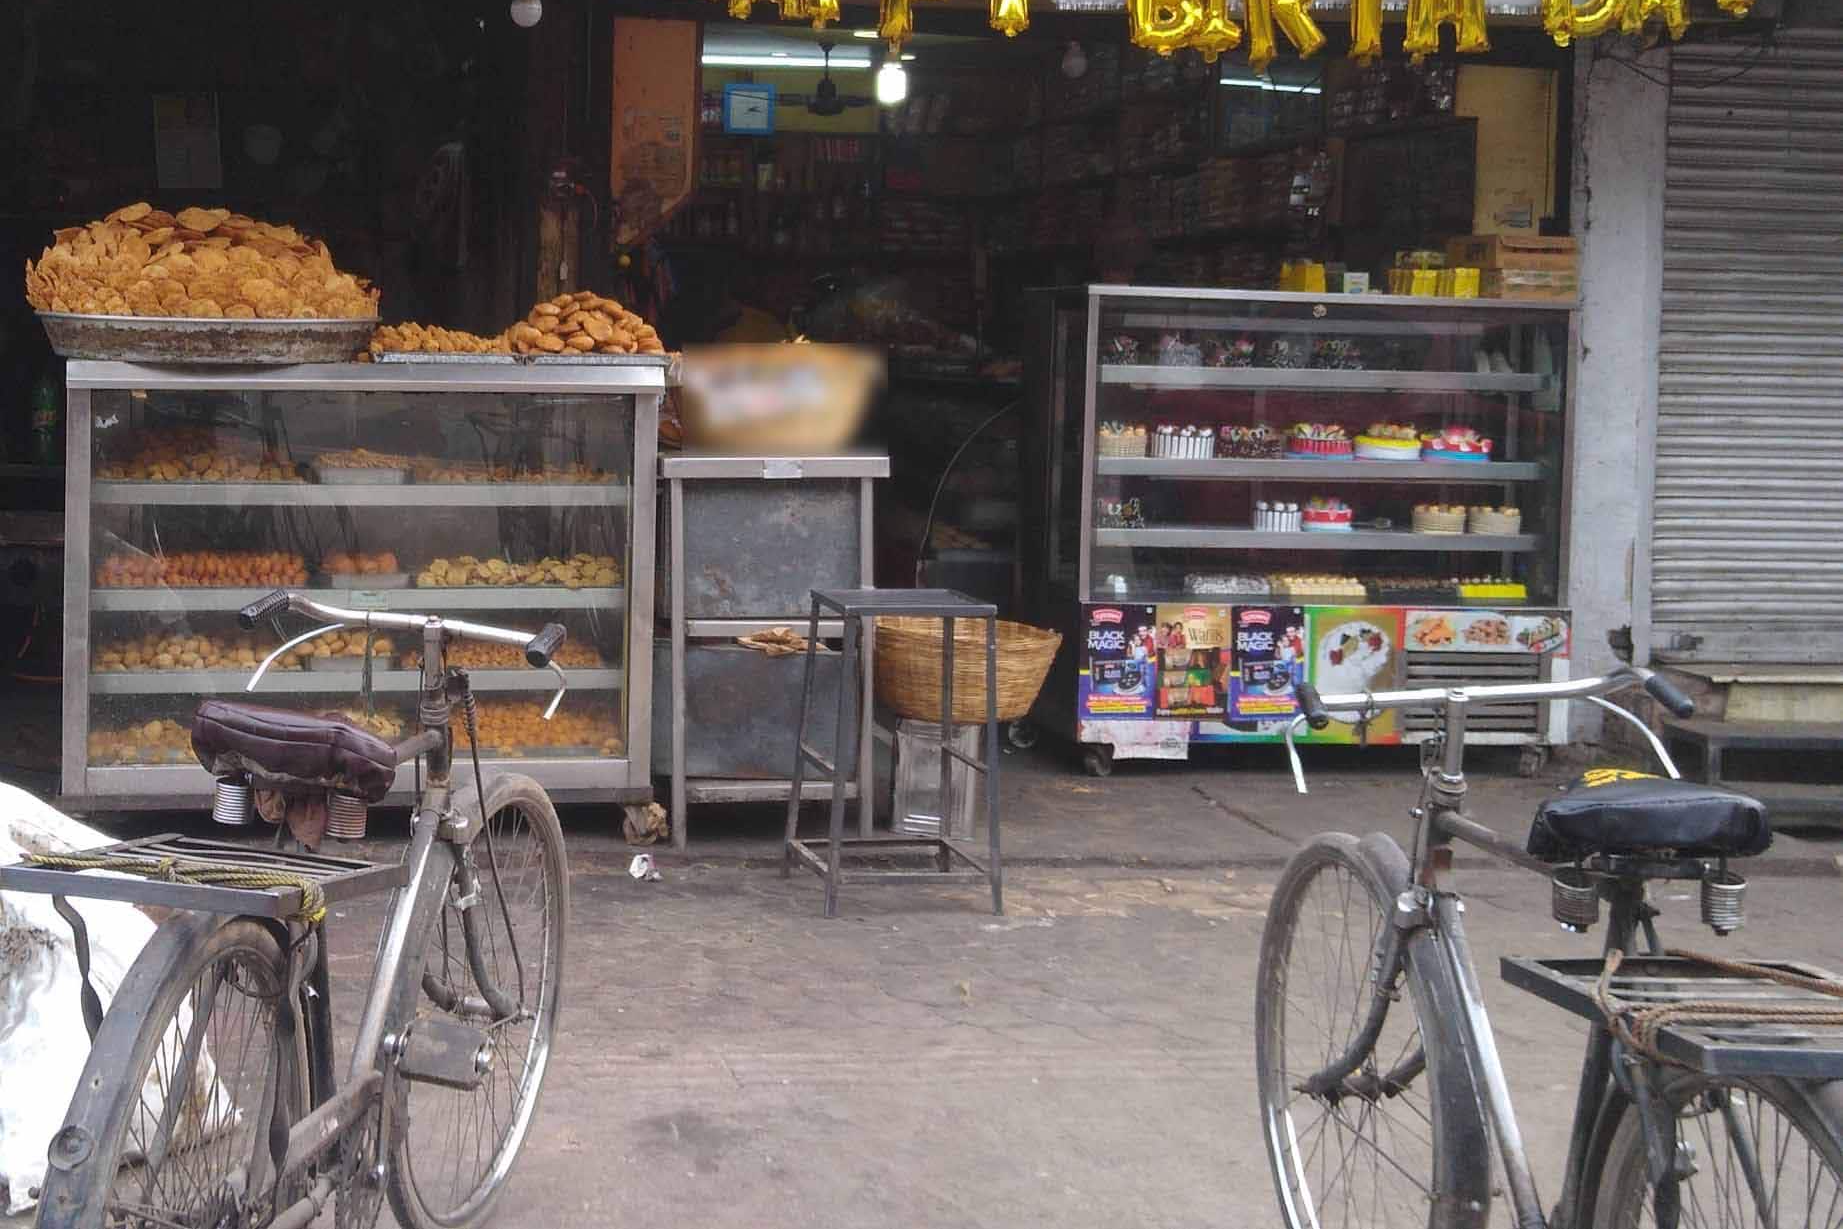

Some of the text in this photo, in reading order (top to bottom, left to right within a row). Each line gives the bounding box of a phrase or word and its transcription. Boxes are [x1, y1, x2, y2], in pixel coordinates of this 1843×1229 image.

[1089, 630, 1125, 640] BLACK
[1237, 631, 1274, 641] BLACK
[1088, 639, 1126, 650] MAGIC
[1237, 640, 1274, 652] MAGIC
